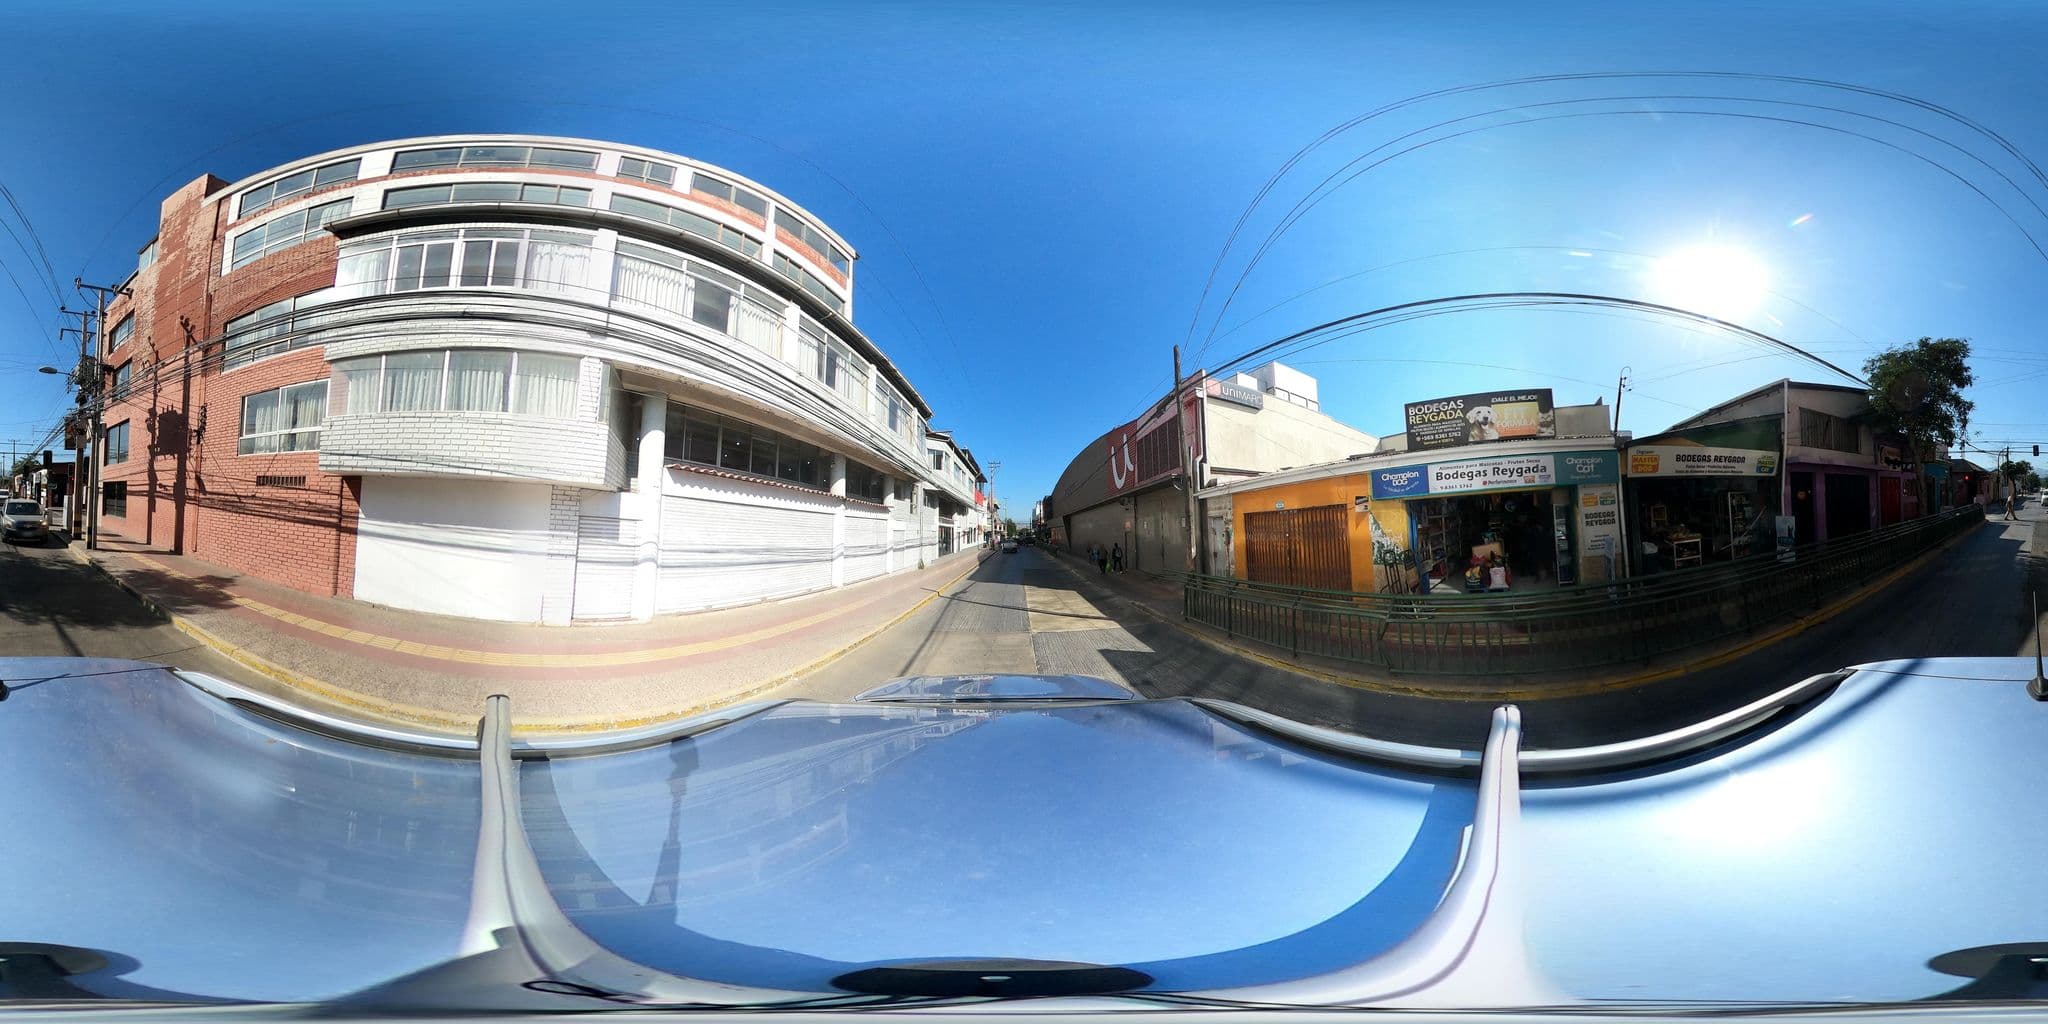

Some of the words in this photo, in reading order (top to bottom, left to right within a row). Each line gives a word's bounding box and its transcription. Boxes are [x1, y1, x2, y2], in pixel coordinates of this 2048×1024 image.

[1408, 399, 1464, 416] BODEGAS
[1409, 409, 1464, 425] REYGADA
[1566, 457, 1604, 465] Champion
[1675, 454, 1712, 463] BODEGAS
[1713, 455, 1746, 464] REYGADA
[1381, 471, 1419, 481] Champion
[1435, 468, 1488, 481] Bodegas
[1493, 464, 1547, 478] Reygada
[1584, 511, 1616, 520] BODEGAS
[1585, 518, 1616, 527] REYGADA
